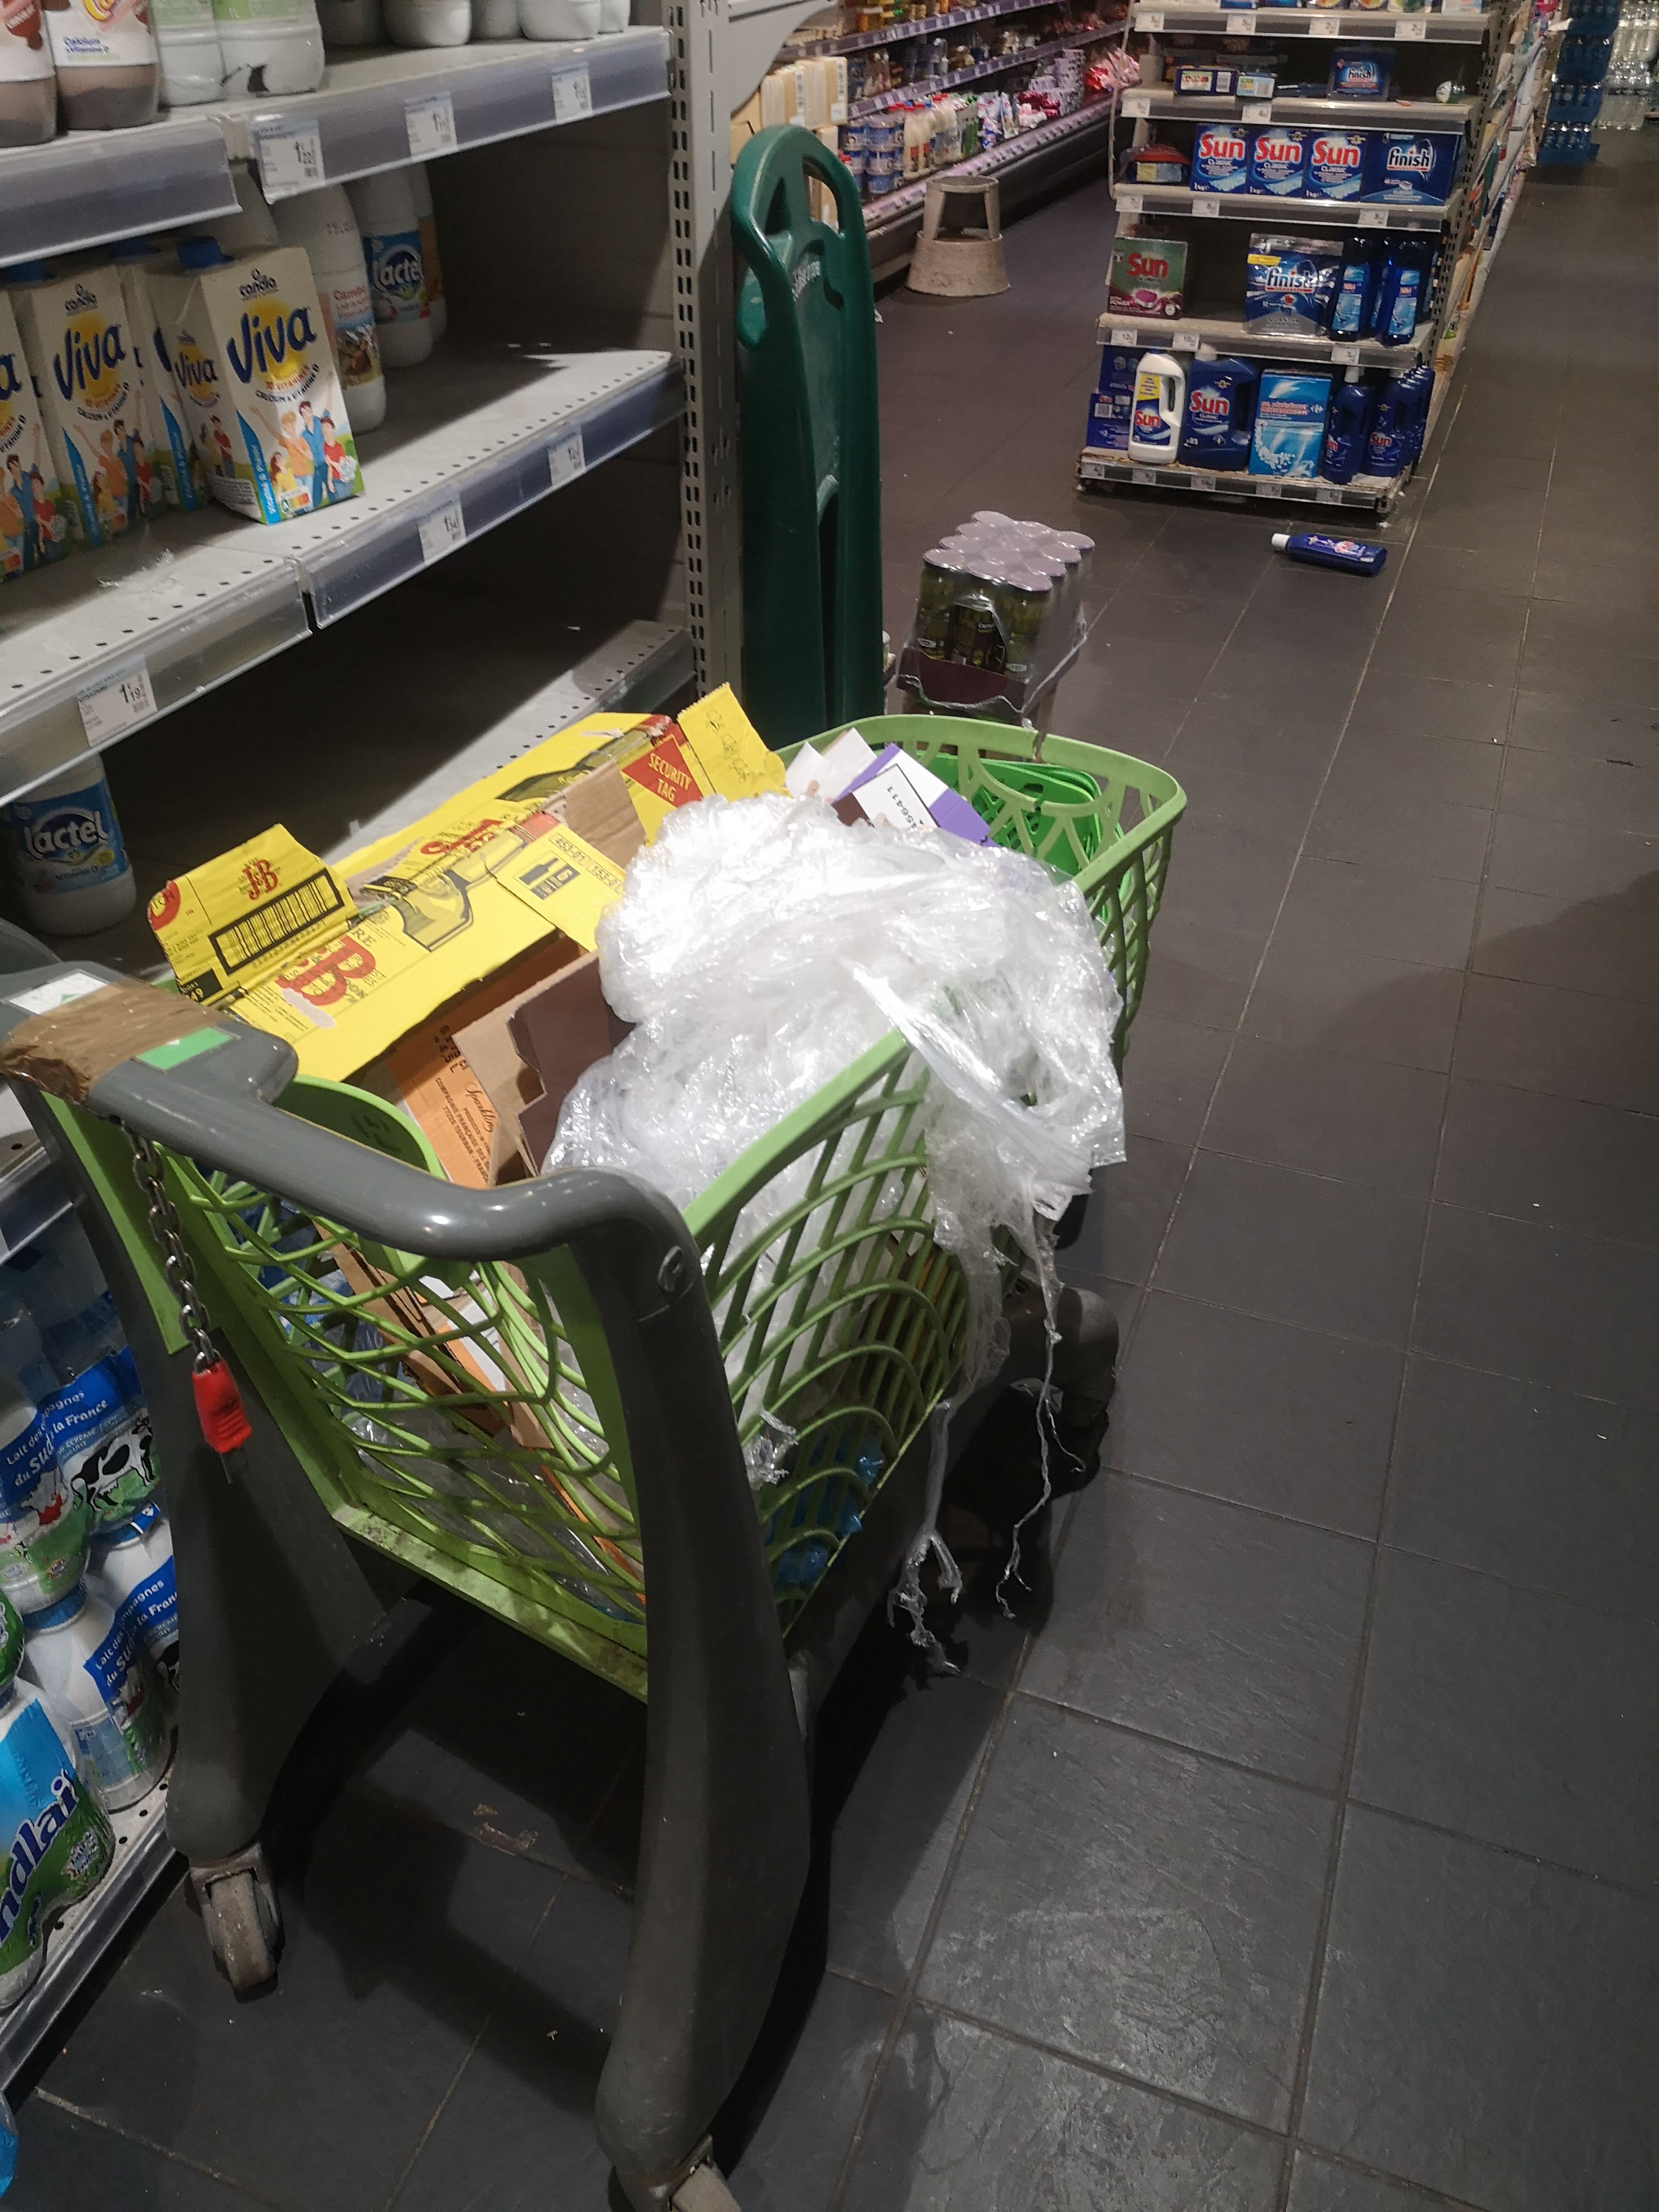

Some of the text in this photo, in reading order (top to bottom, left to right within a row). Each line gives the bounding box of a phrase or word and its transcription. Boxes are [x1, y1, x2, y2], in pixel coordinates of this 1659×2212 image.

[1200, 133, 1244, 159] Sun
[1256, 137, 1301, 162] Sun
[1313, 140, 1359, 166] Sun
[1388, 147, 1431, 167] finish
[1127, 252, 1168, 278] Sun
[226, 307, 318, 384] Viva
[54, 324, 128, 401] Viva
[174, 351, 219, 389] Viva
[1190, 391, 1229, 415] Sun
[1134, 410, 1161, 428] Sun
[647, 753, 692, 791] SECURITY
[658, 777, 677, 802] TAG
[241, 859, 278, 901] J&B
[6, 1443, 29, 1465] Lait
[14, 1471, 31, 1487] du
[52, 1422, 65, 1433] la
[65, 1399, 108, 1427] France
